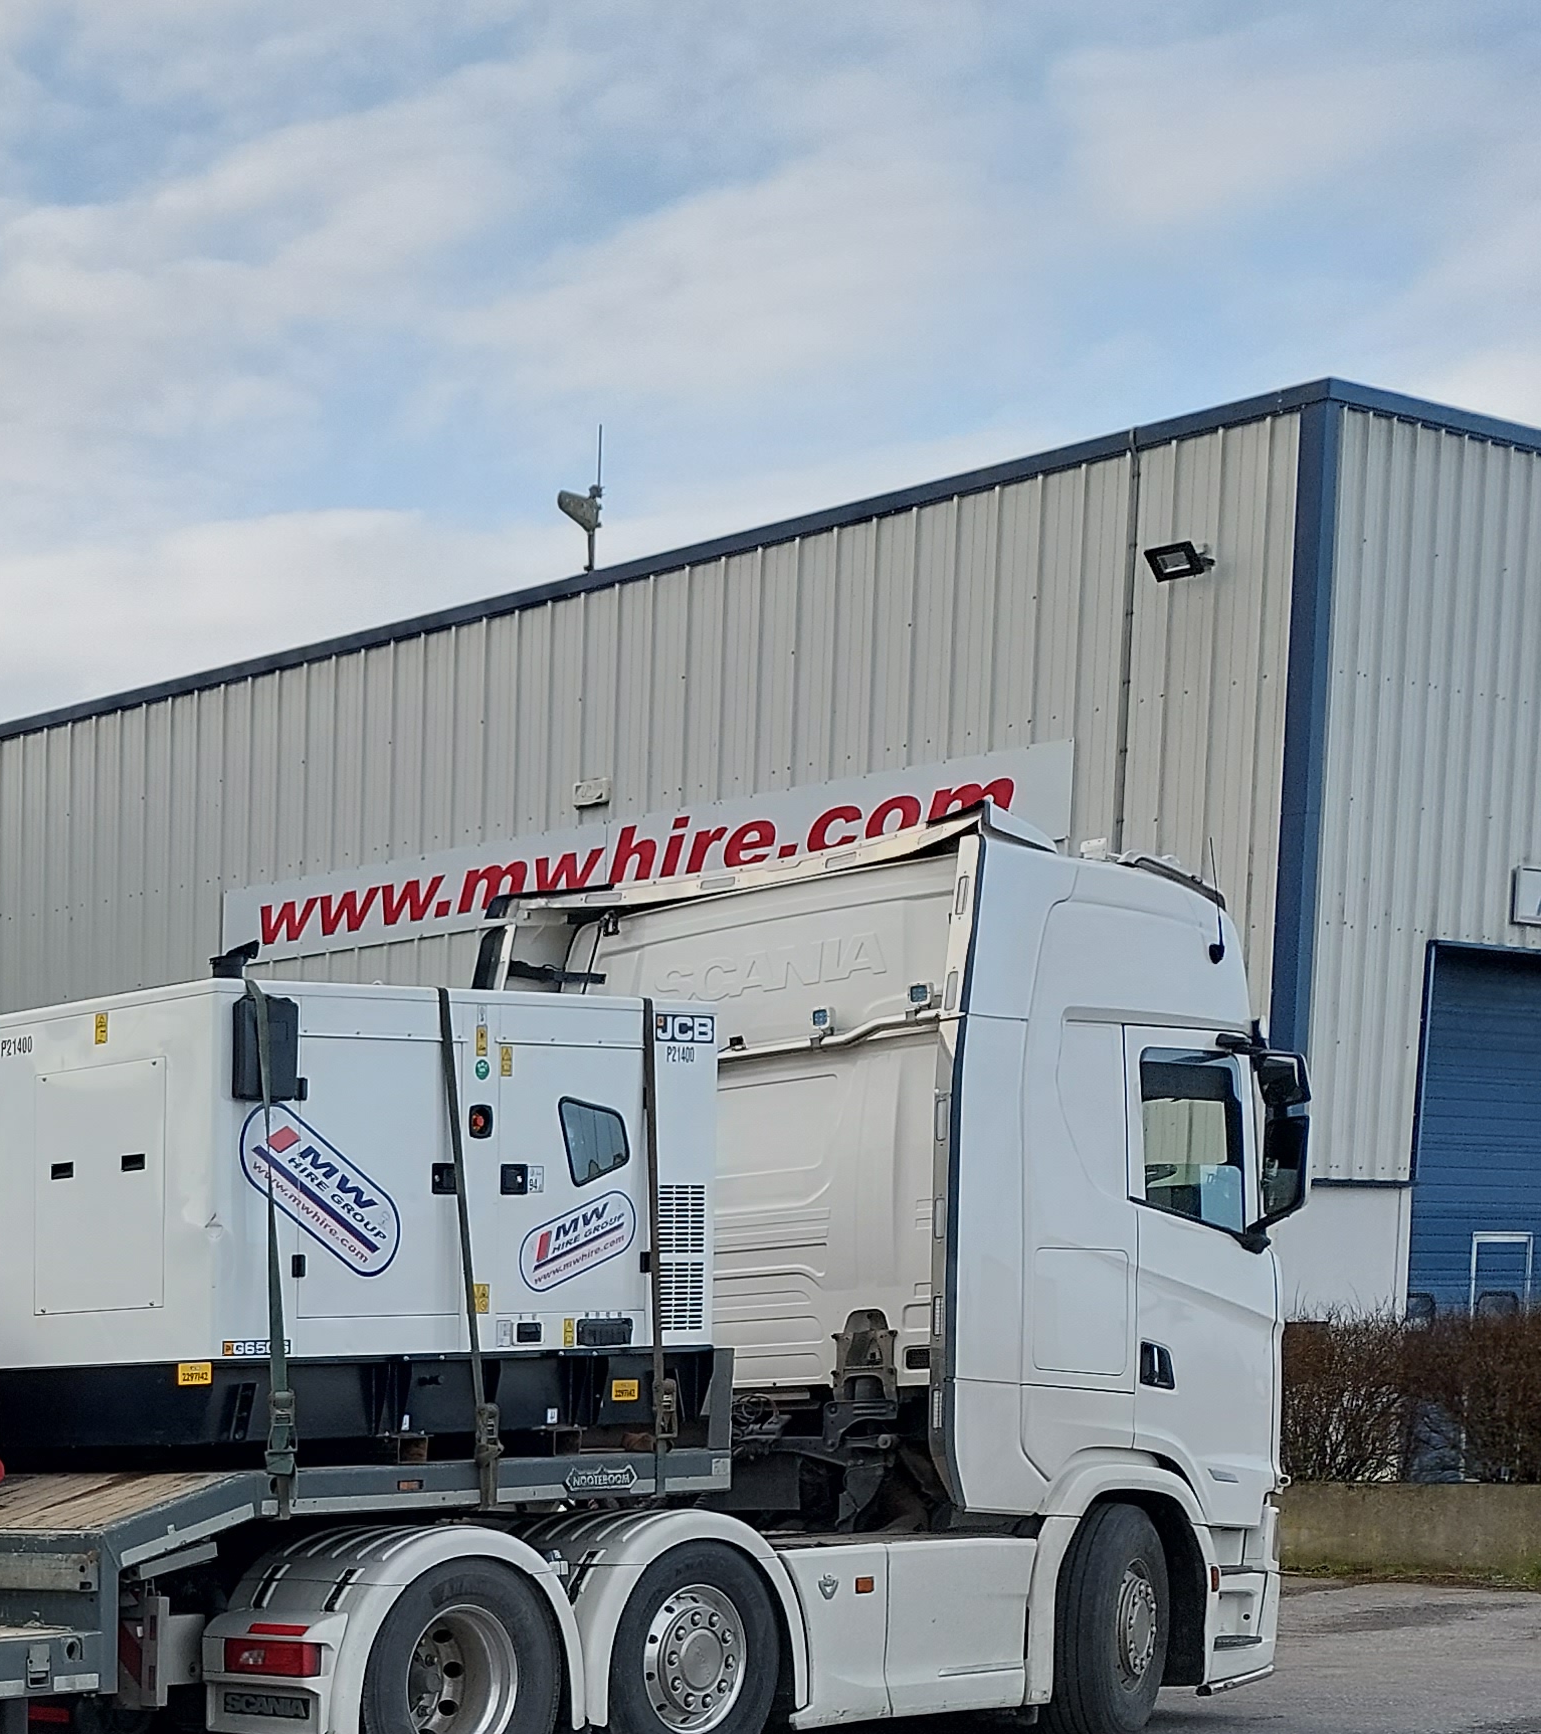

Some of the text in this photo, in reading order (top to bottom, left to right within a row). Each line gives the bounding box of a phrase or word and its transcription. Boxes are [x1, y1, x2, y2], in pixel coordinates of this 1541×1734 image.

[654, 932, 888, 1001] SCANIA
[657, 1016, 714, 1041] JCB
[287, 1157, 387, 1240] HIRE GROUP
[299, 1145, 379, 1210] MW
[551, 1212, 625, 1255] HIRE GROUP
[554, 1201, 610, 1242] MW
[534, 1234, 625, 1285] www.mwhire.com
[572, 1473, 630, 1487] NOOTEBOOM
[225, 1693, 306, 1718] SCANIA
